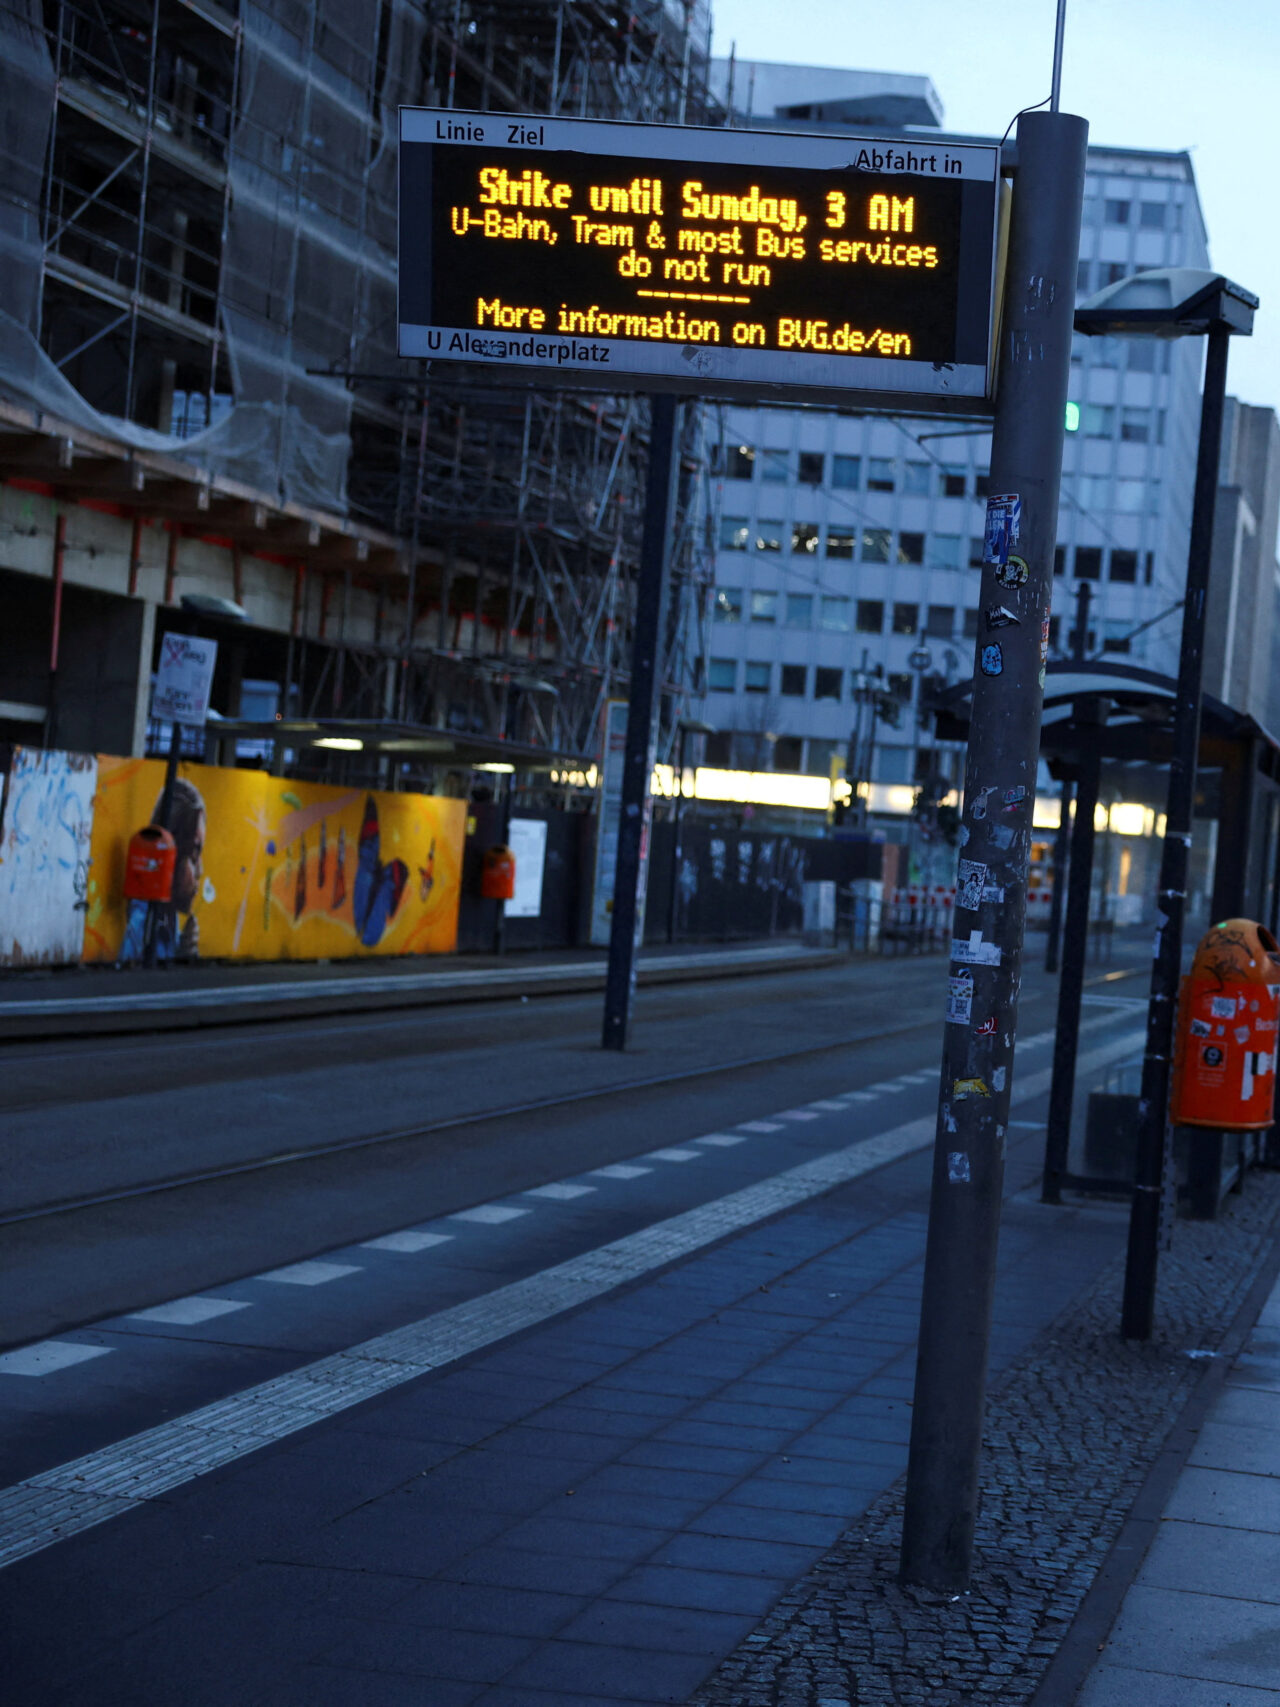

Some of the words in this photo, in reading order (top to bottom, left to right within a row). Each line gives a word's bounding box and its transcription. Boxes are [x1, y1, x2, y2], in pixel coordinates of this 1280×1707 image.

[436, 120, 485, 142] Linie
[507, 125, 544, 146] Ziel
[856, 148, 937, 173] Abfahrt
[944, 153, 962, 175] in
[479, 167, 572, 209] Strike
[589, 178, 664, 216] until
[682, 181, 808, 232] Sunday,
[825, 191, 847, 229] 3
[868, 194, 915, 233] AM
[451, 206, 558, 246] U-Bahn,
[570, 214, 635, 248] Tram
[645, 220, 667, 250] &
[678, 226, 745, 256] most
[756, 227, 807, 259] Bus
[819, 236, 939, 268] services
[618, 249, 653, 278] do
[664, 253, 711, 283] not
[723, 262, 771, 286] run
[427, 330, 441, 350] U
[477, 297, 546, 330] More
[558, 303, 720, 342] information
[732, 322, 766, 346] on
[778, 318, 912, 356] BVG.de/en
